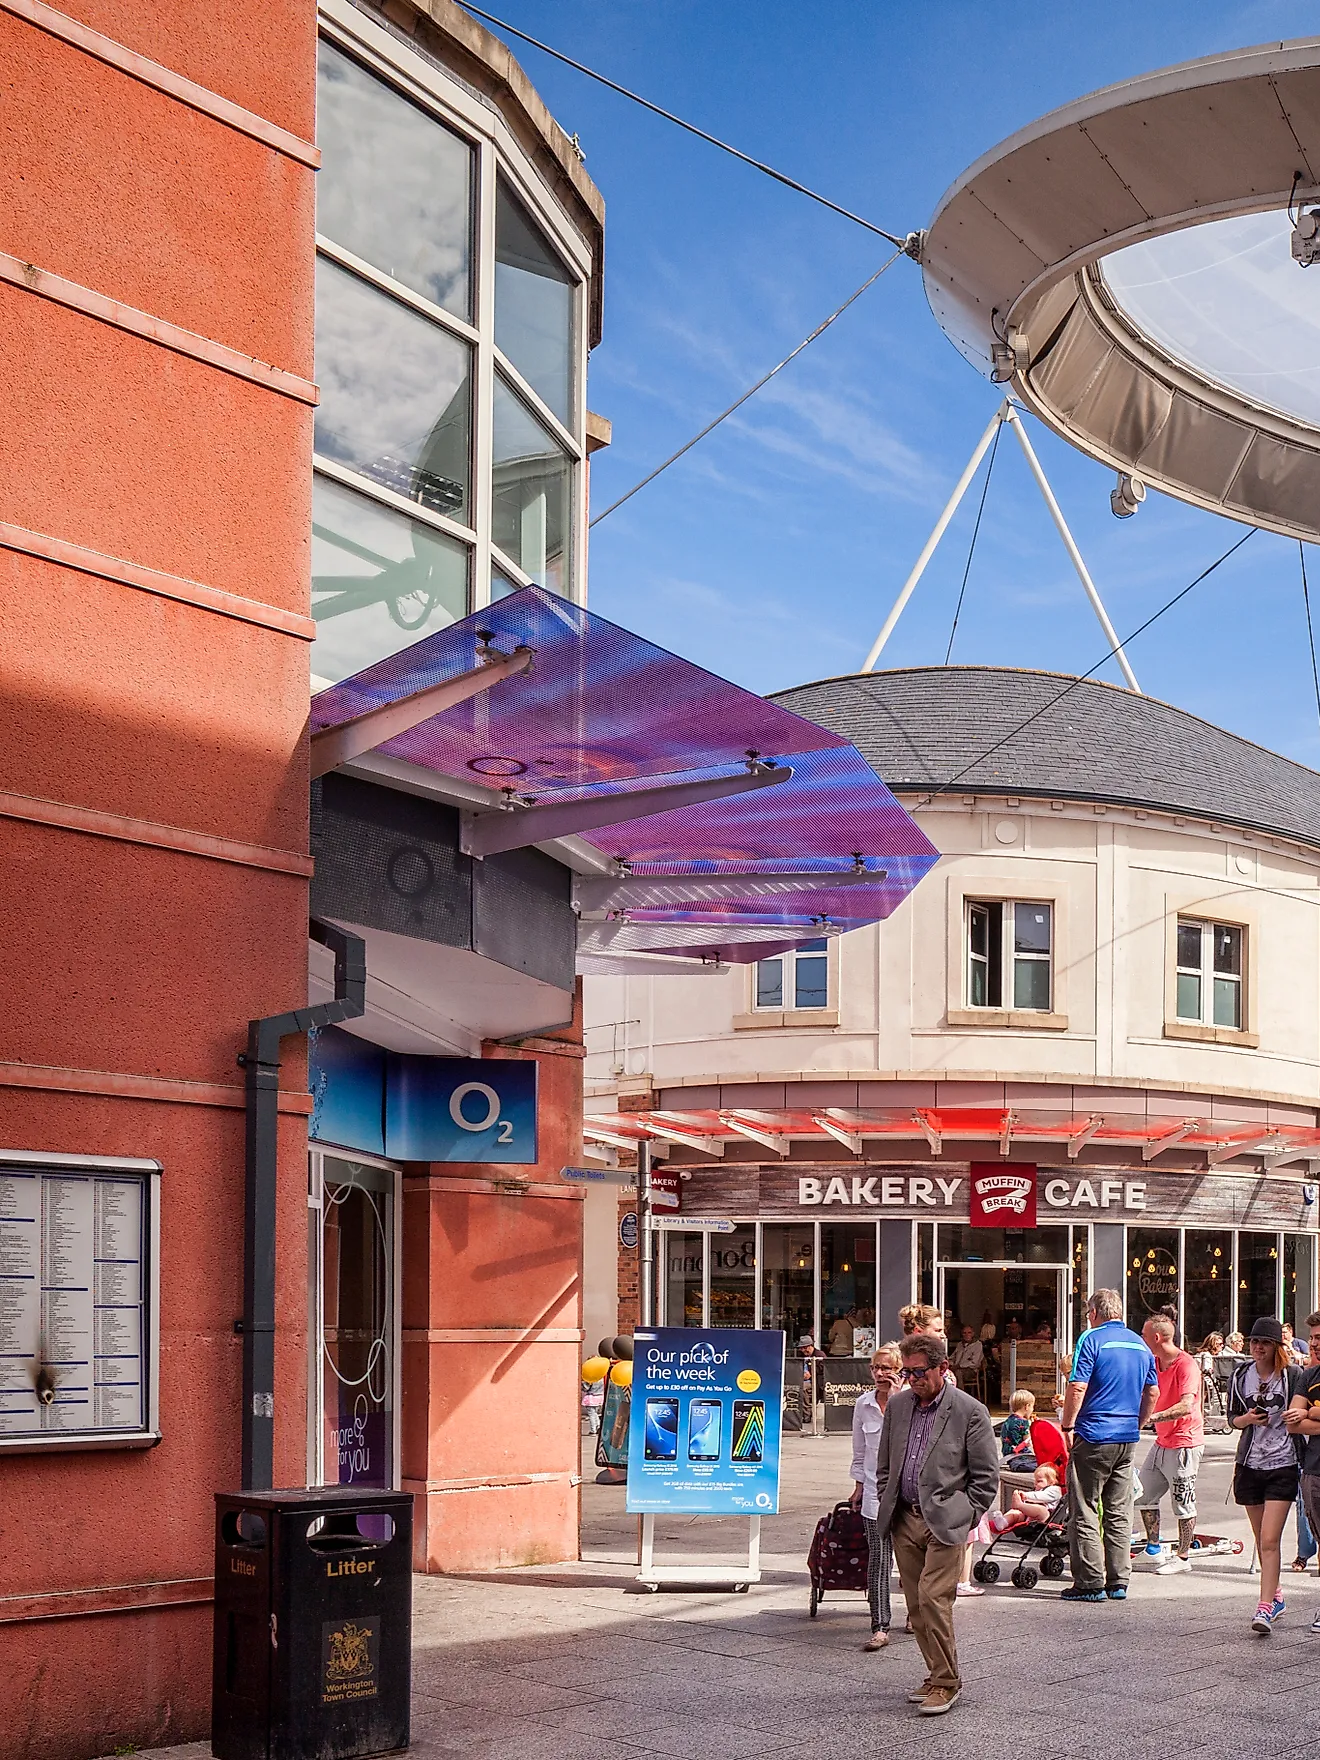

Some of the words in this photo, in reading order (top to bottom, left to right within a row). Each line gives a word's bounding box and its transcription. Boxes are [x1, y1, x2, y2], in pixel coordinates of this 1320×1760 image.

[566, 1169, 585, 1178] Public
[586, 1171, 606, 1180] Toilets
[980, 1178, 1027, 1189] MUFFIN
[798, 1177, 962, 1206] BAKERY
[1044, 1179, 1147, 1210] CAFE
[985, 1198, 1022, 1208] BREAK
[647, 1348, 676, 1363] Our
[680, 1349, 709, 1366] pick
[713, 1350, 730, 1364] of
[646, 1365, 671, 1379] the
[675, 1366, 716, 1381] week
[331, 1427, 353, 1447] more
[337, 1447, 347, 1465] for
[348, 1448, 370, 1483] you
[231, 1558, 256, 1576] Litter
[326, 1559, 376, 1577] Litter
[326, 1679, 374, 1693] Workington
[322, 1692, 344, 1703] Town
[345, 1687, 377, 1699] Council
